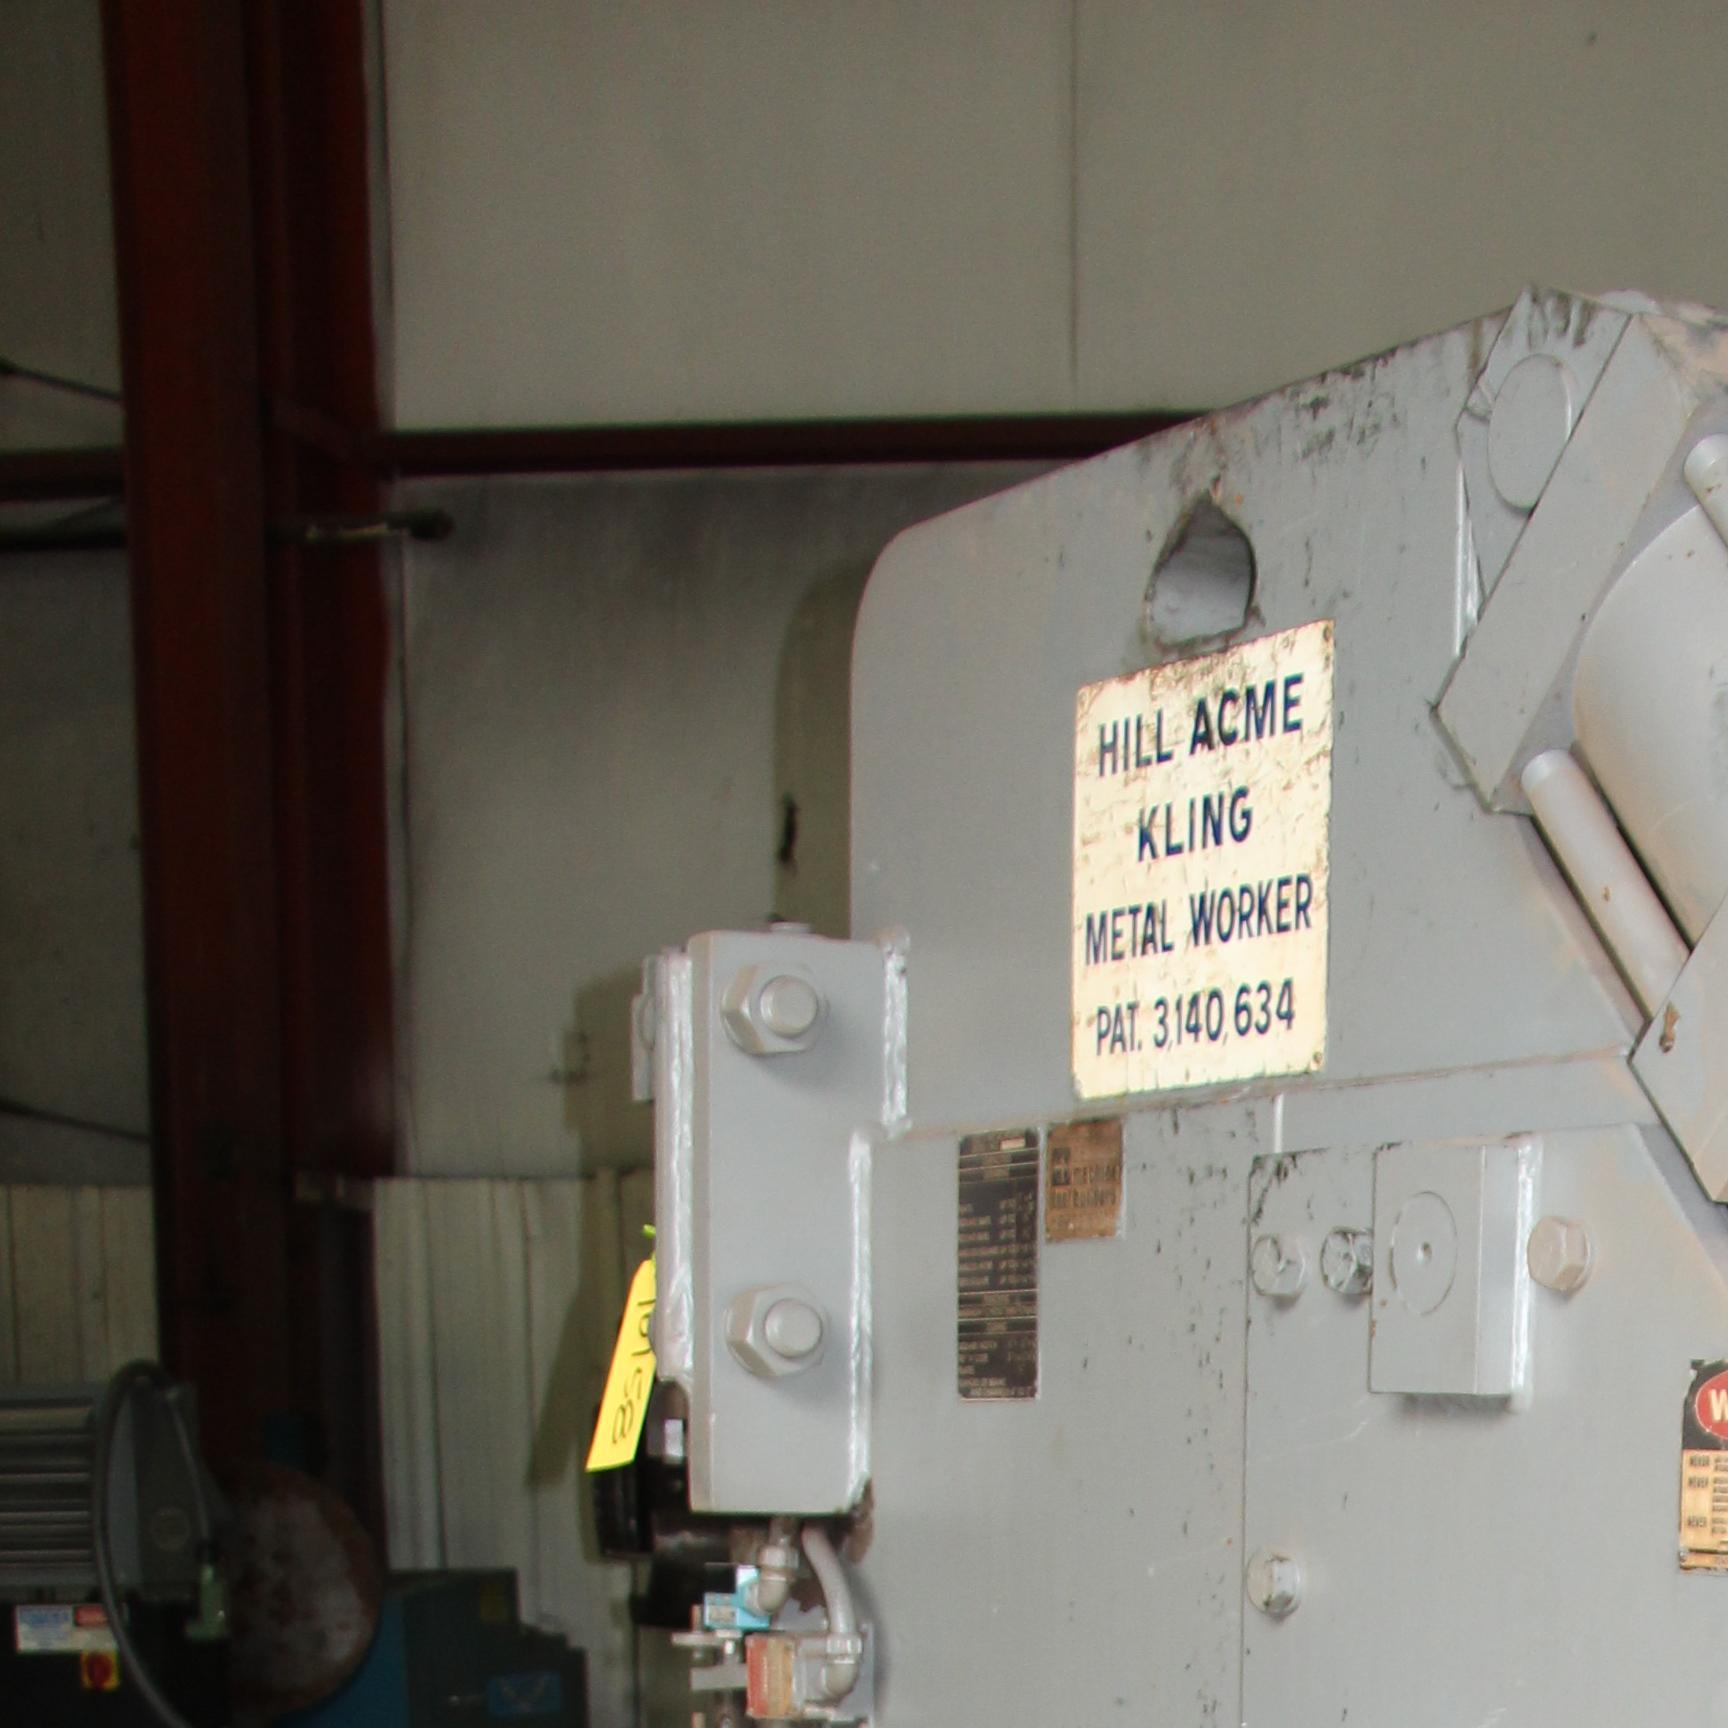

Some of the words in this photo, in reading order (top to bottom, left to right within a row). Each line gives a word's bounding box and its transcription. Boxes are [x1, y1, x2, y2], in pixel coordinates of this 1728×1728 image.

[1099, 708, 1174, 777] HILL
[1189, 672, 1305, 757] ACME
[1138, 786, 1254, 862] KLING
[1085, 898, 1174, 966] METAL
[1189, 872, 1313, 948] WORKER
[1096, 1002, 1142, 1057] PAT.
